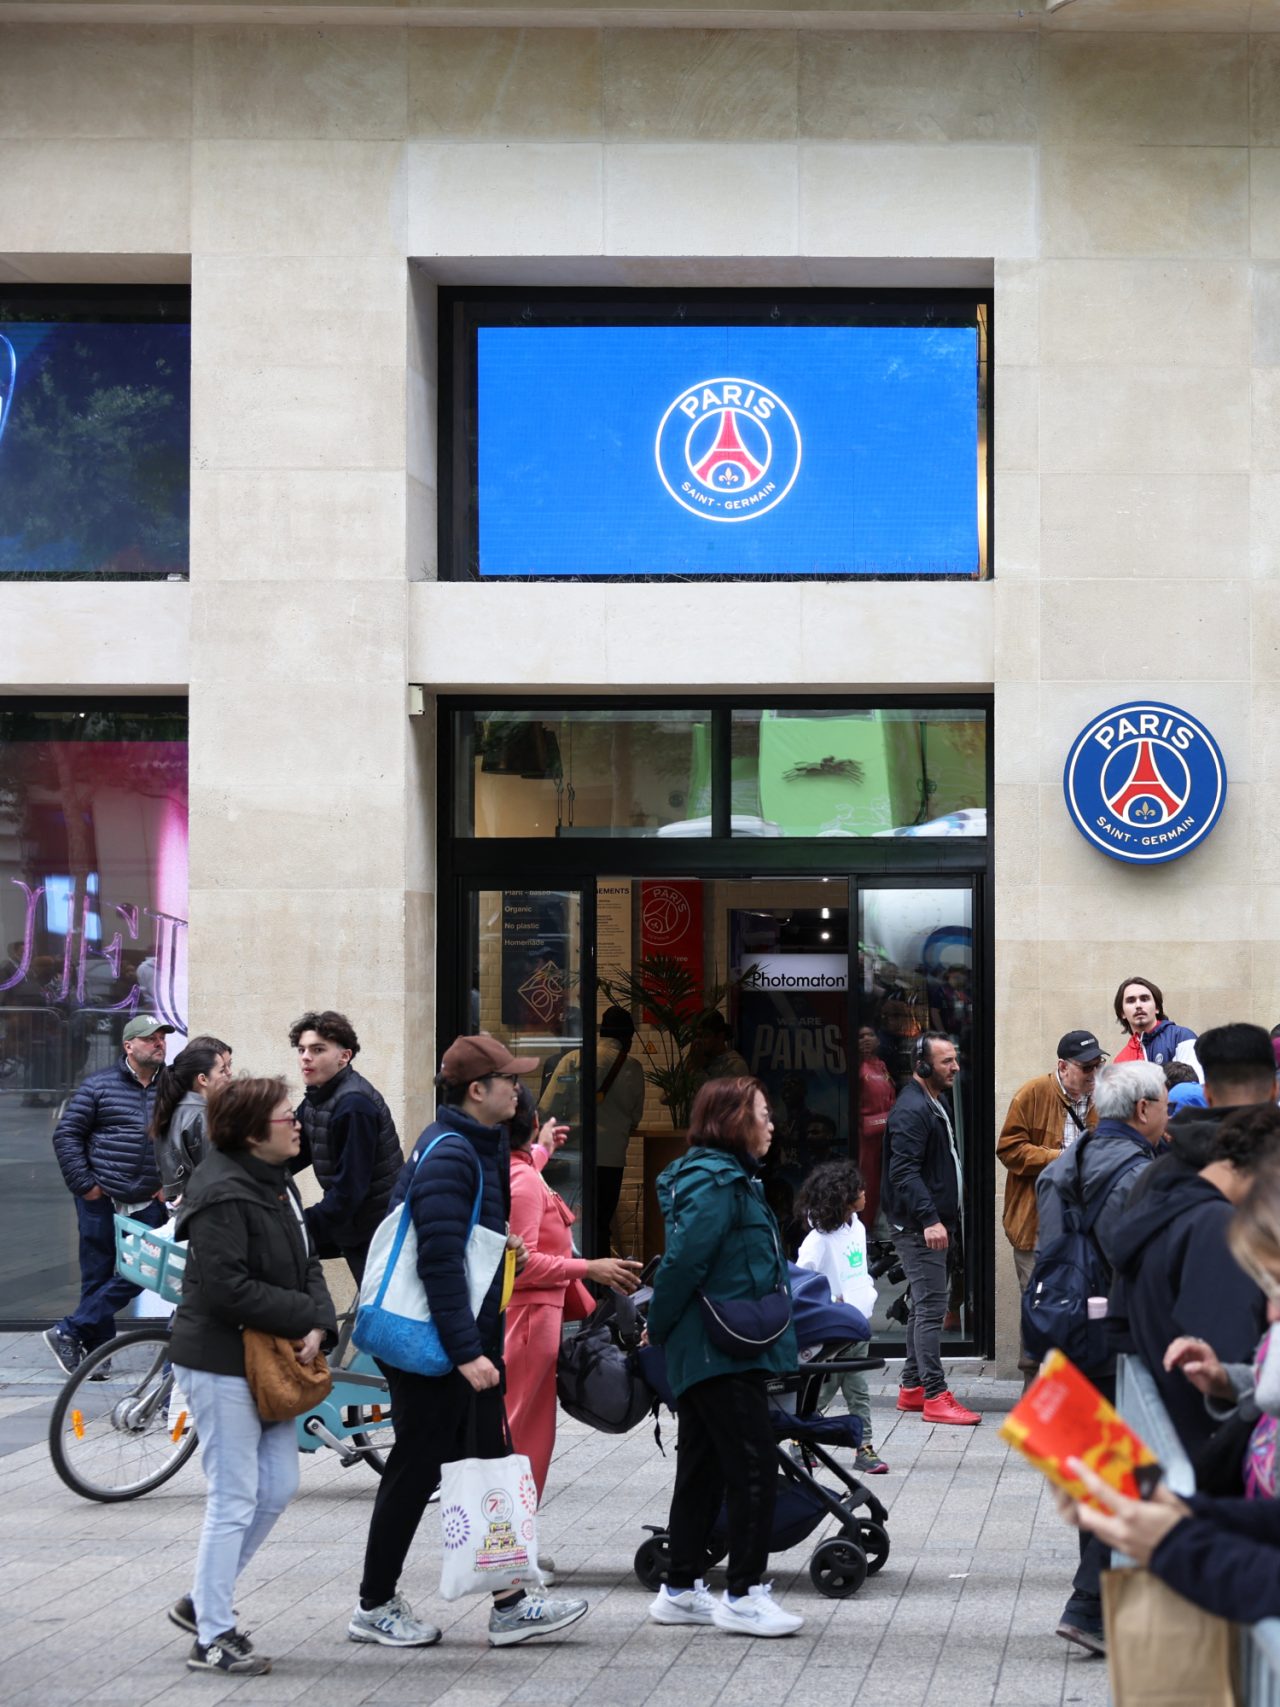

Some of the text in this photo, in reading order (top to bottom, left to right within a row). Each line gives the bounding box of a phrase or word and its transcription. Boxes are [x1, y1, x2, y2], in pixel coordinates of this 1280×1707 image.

[679, 384, 776, 420] PARIS
[1094, 714, 1194, 751] PARIS
[504, 905, 533, 914] Organic
[653, 889, 687, 913] PARIS
[504, 922, 540, 932] No plastic
[504, 939, 545, 947] Homemade
[753, 971, 845, 987] Photomaton
[752, 1024, 847, 1074] PARIS
